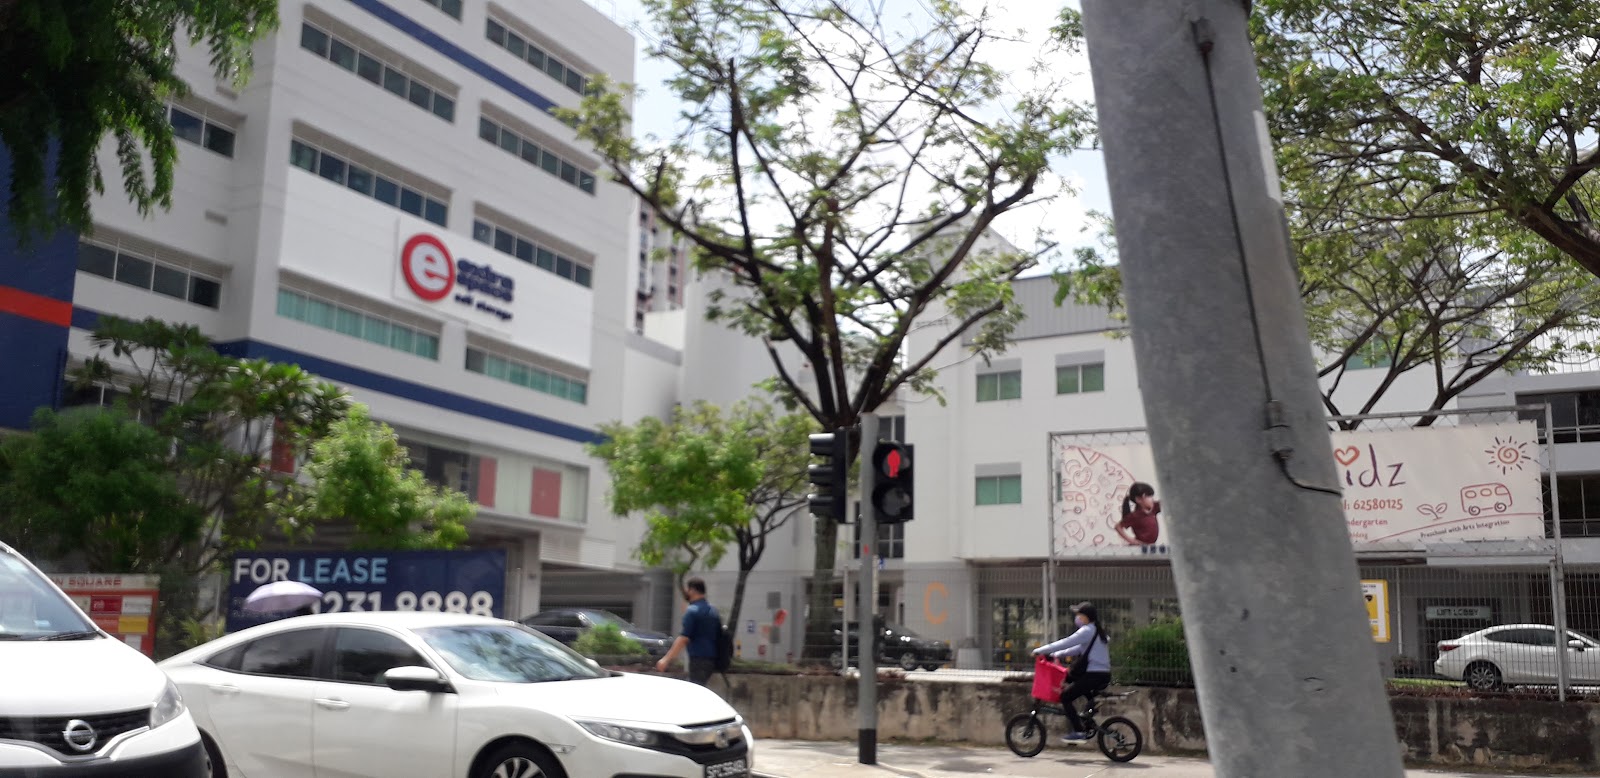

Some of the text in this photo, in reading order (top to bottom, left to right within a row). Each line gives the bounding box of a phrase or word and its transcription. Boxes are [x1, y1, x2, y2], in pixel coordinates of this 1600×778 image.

[1339, 443, 1407, 488] idz
[1353, 498, 1404, 511] 62580125
[1420, 519, 1510, 539] Preschool with Arts Integration
[68, 576, 121, 586] SQUARE
[234, 557, 388, 585] FOR LEASE
[311, 590, 494, 618] 231 8888
